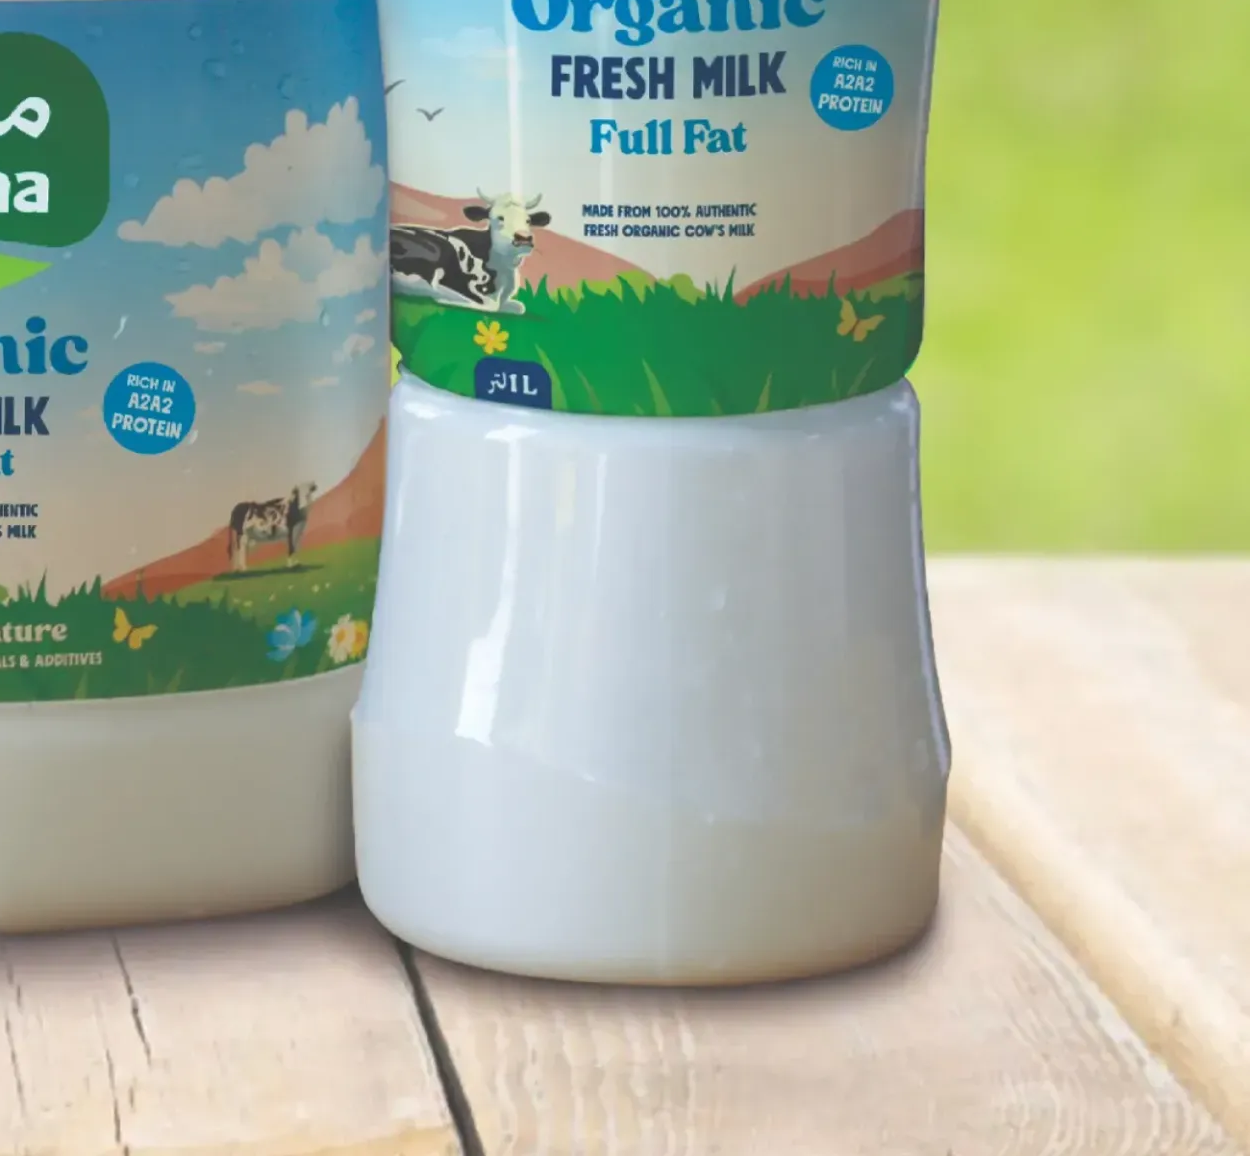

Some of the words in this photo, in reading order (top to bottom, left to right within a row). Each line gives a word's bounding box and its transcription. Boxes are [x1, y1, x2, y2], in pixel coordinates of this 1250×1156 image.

[833, 56, 862, 71] RICH
[865, 60, 878, 72] IN
[551, 55, 675, 100] FRESH
[693, 51, 787, 99] MILK
[834, 73, 875, 92] A2A2
[818, 93, 883, 114] PROTEIN
[589, 119, 673, 155] Full
[683, 119, 747, 154] Fat
[582, 204, 614, 217] MADE
[618, 205, 651, 218] FROM
[655, 206, 691, 218] 100%
[696, 203, 757, 218] AUTHENTIC
[584, 224, 618, 237] FRESH
[622, 224, 680, 237] ORGANIC
[685, 224, 725, 237] COW'S
[729, 223, 756, 236] MILK
[127, 373, 159, 390] RICH
[162, 379, 176, 393] IN
[127, 391, 173, 414] A2A2
[111, 412, 183, 440] PROTEIN
[7, 525, 36, 538] MILK
[20, 655, 29, 668] &
[34, 652, 103, 667] ADDITIVES
